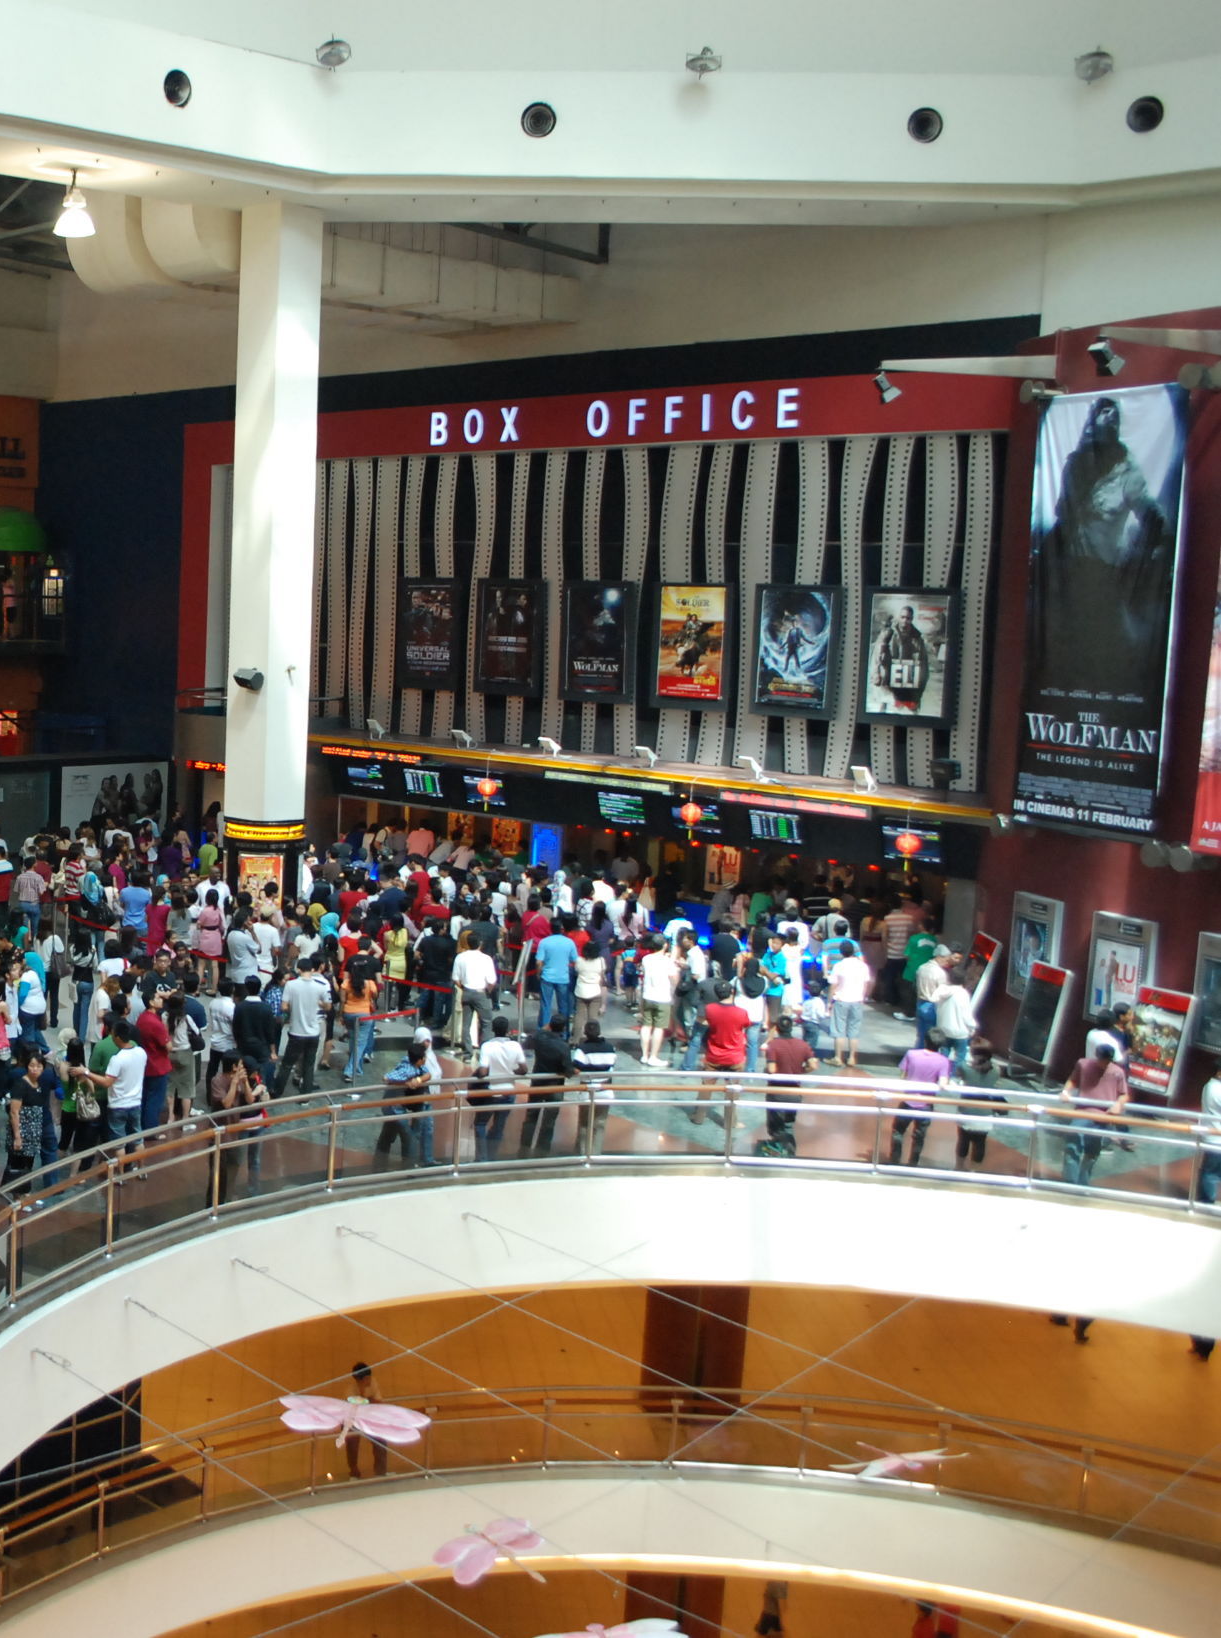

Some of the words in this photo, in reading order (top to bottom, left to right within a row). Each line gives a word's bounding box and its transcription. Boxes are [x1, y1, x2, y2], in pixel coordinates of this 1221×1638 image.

[430, 406, 520, 447] BOX
[586, 387, 800, 438] OFFICE
[406, 651, 450, 660] SOLDIER
[573, 661, 619, 673] WOLFMAN
[890, 664, 920, 688] ELI
[1078, 711, 1100, 722] THE
[1025, 712, 1157, 754] WOLFMAN
[1036, 752, 1052, 762] THE
[1056, 756, 1091, 766] LEGEND
[1094, 760, 1104, 768] IS
[1107, 762, 1135, 772] ALIVE
[1013, 799, 1026, 811] IN
[1026, 801, 1075, 819] CINEMAS
[1077, 808, 1090, 821] 11
[1092, 811, 1154, 832] FEBRUARY
